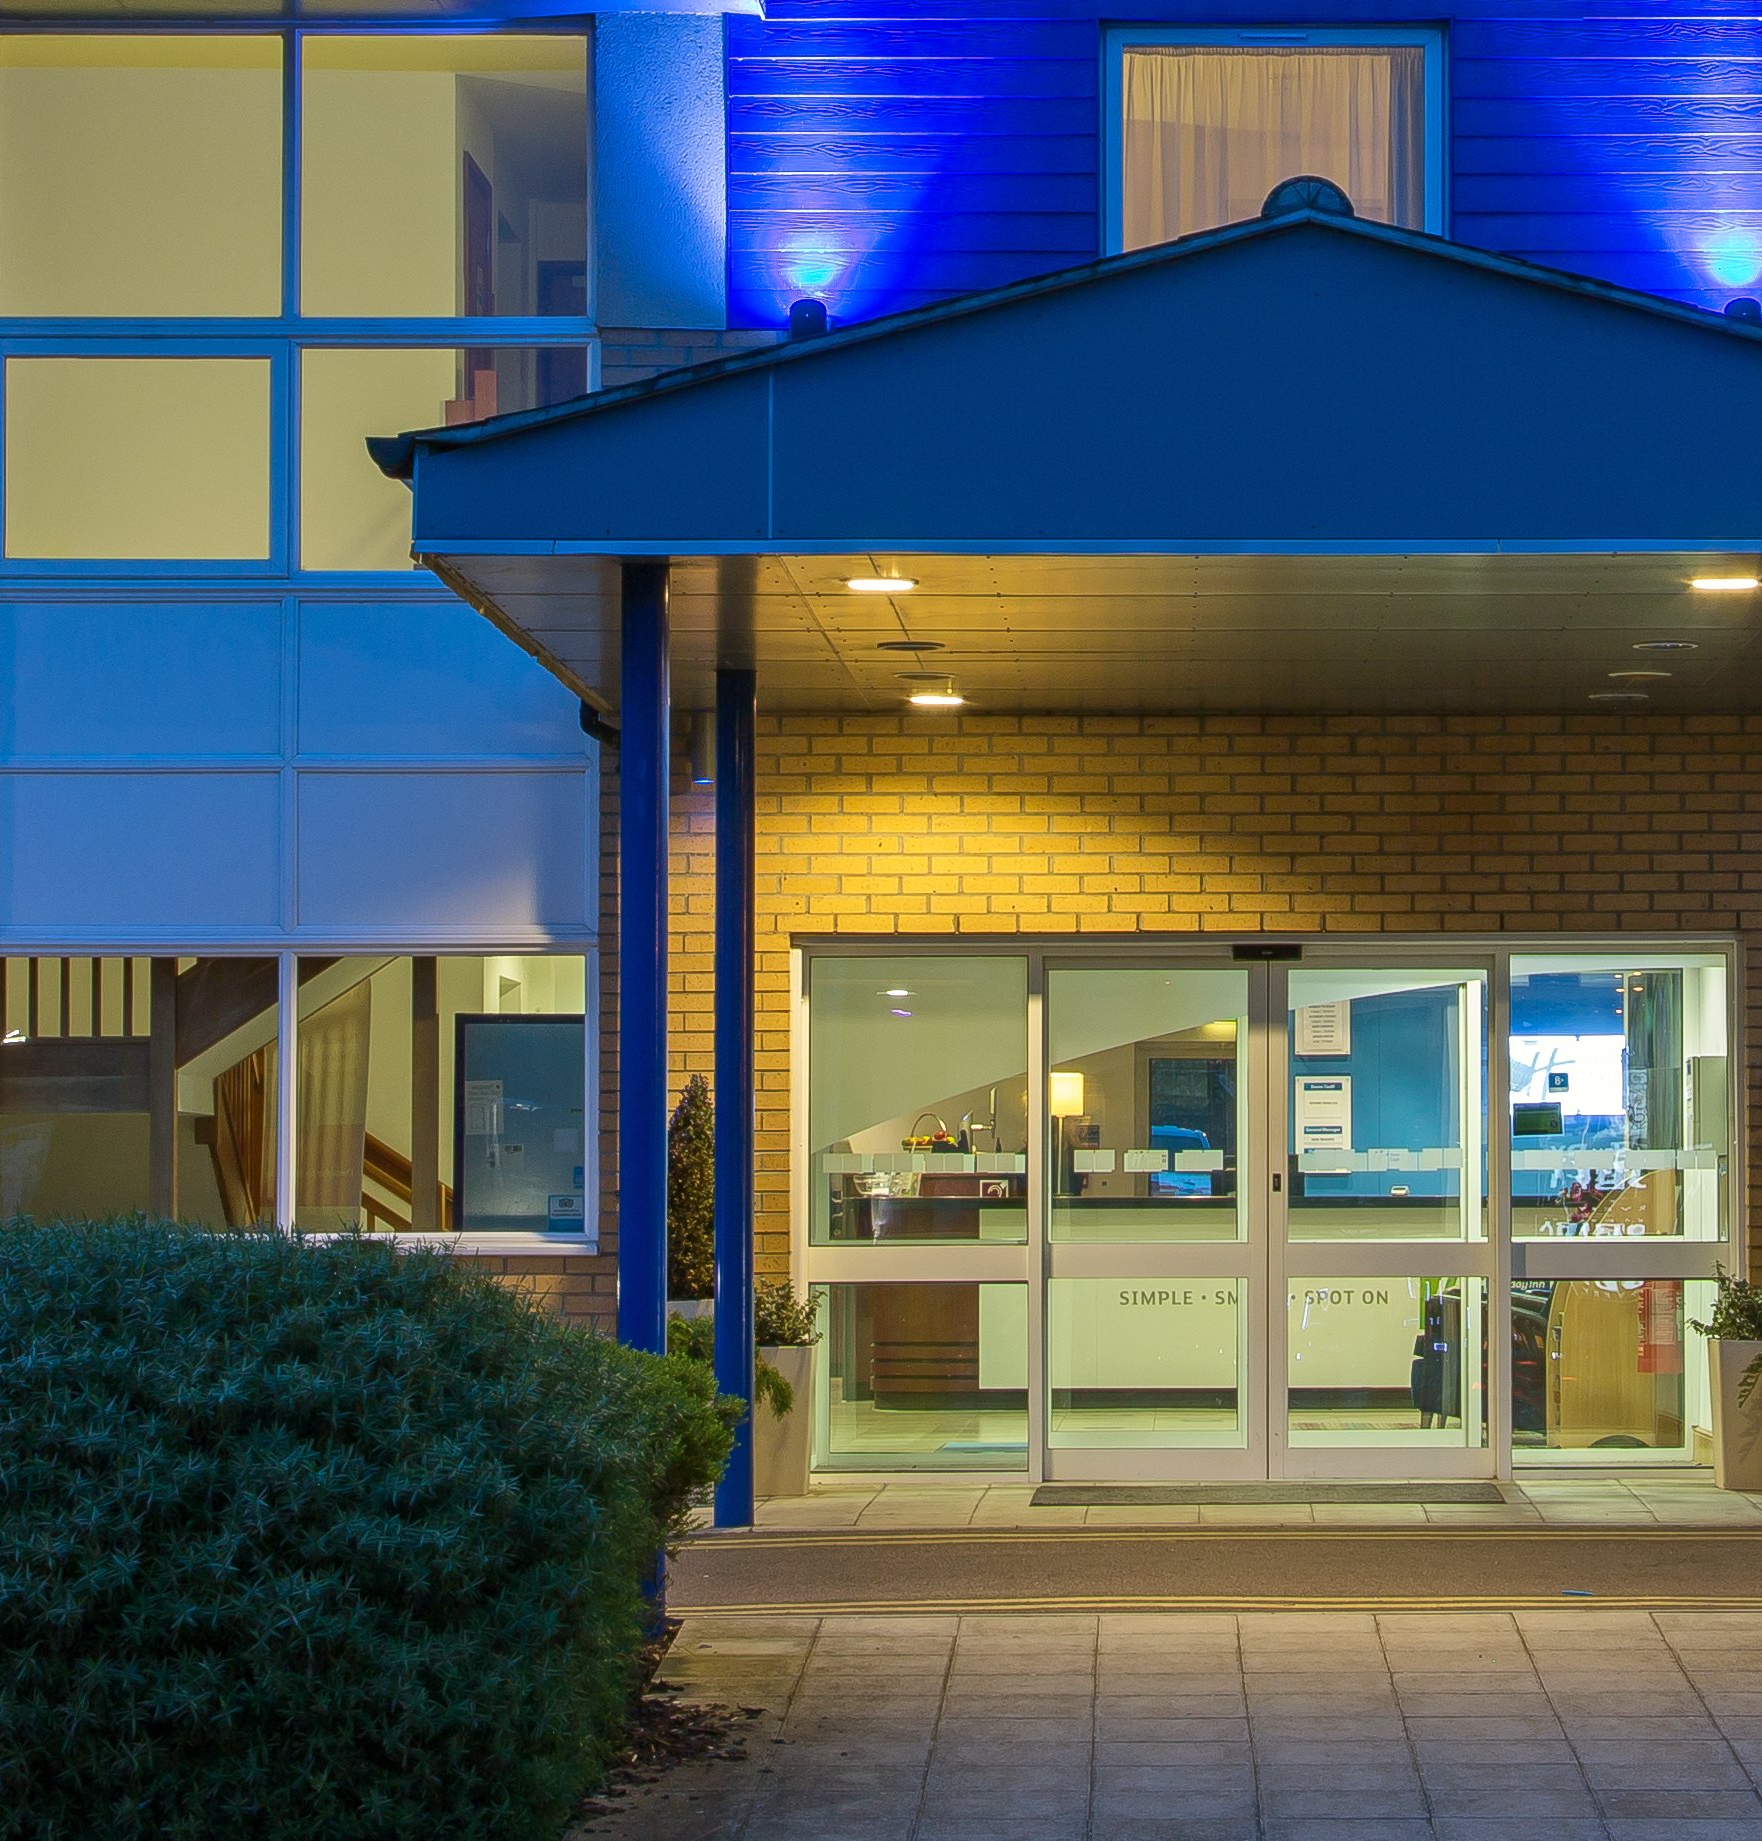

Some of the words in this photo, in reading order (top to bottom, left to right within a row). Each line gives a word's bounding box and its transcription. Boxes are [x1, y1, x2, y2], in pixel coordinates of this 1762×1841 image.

[1119, 1290, 1193, 1305] SIMPLE
[1214, 1290, 1237, 1305] SM
[1304, 1290, 1355, 1305] SPOT
[1362, 1290, 1389, 1305] ON
